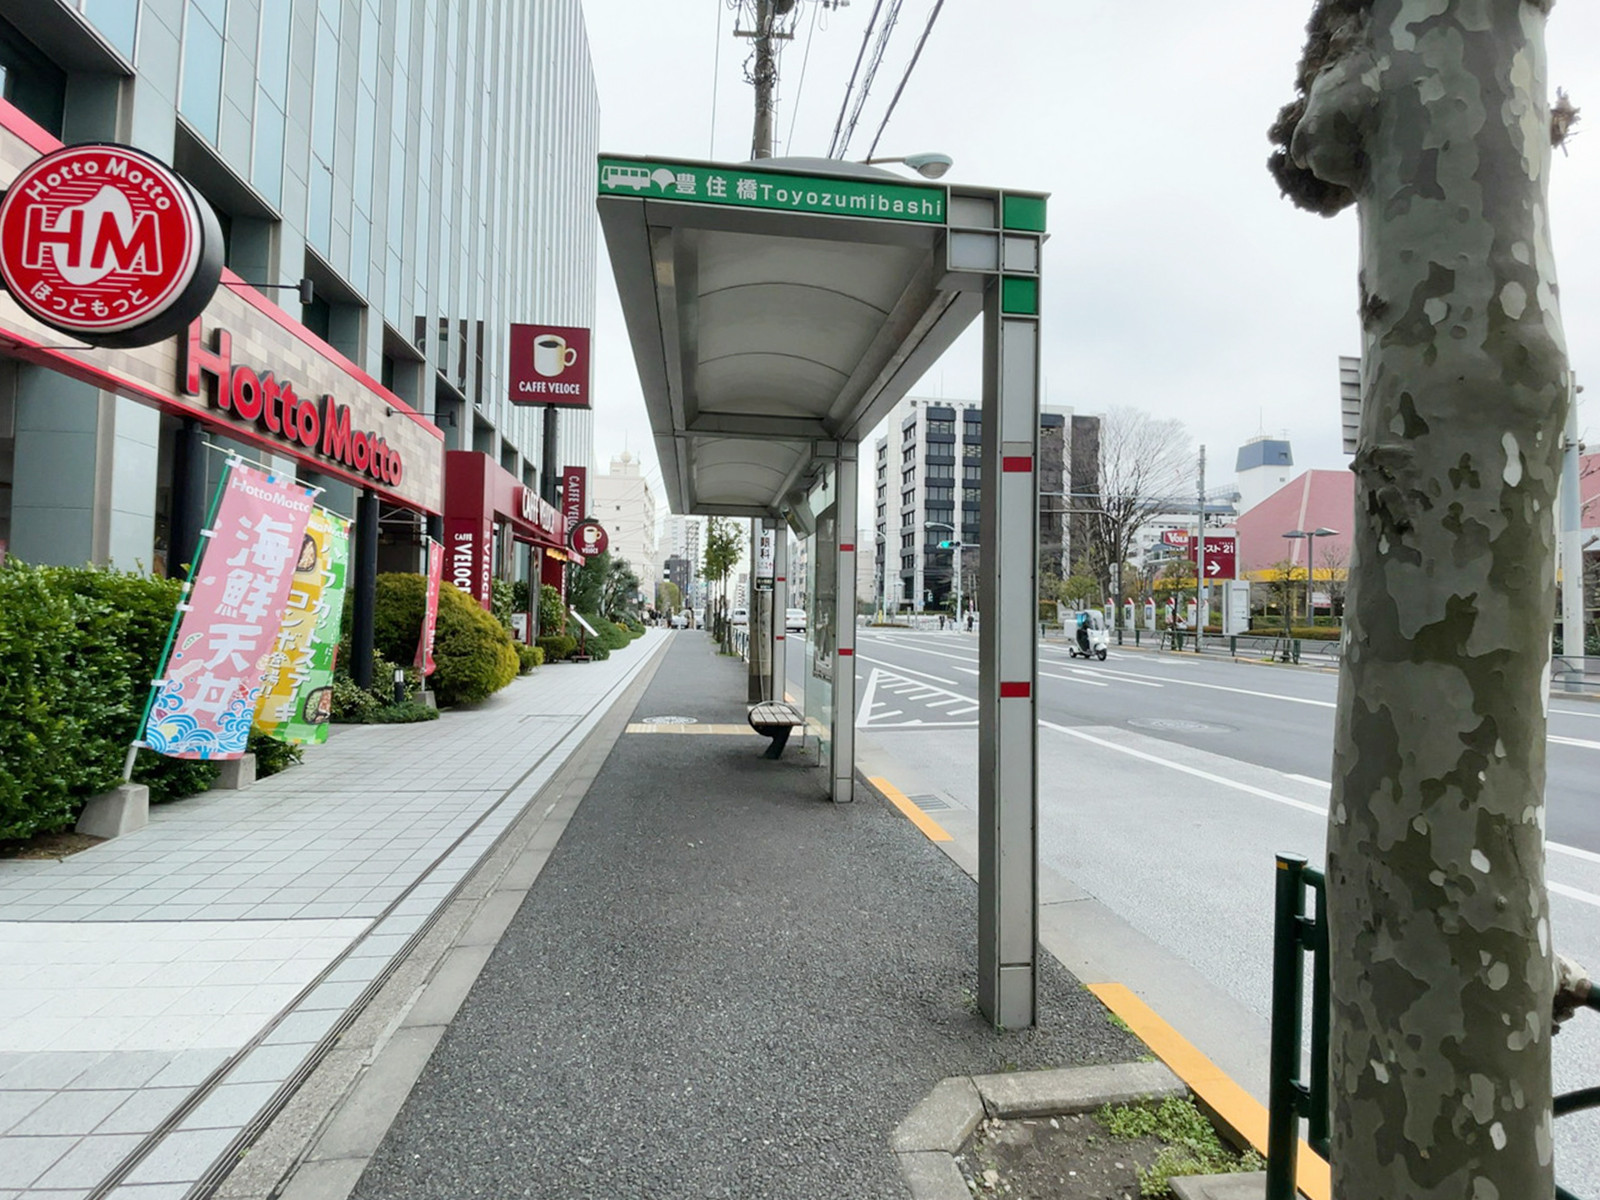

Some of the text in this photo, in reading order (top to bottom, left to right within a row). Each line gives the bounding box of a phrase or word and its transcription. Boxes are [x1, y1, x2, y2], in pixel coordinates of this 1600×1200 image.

[25, 156, 171, 211] Hotto Motto
[675, 171, 943, 217] 豊住橋 Toyozumibashi
[22, 204, 163, 276] HM
[29, 279, 149, 318] ほっともっと
[518, 380, 581, 395] CAFFE VELOCE
[454, 533, 473, 541] CAFFE
[1222, 544, 1234, 554] 21
[184, 513, 295, 722] 海鮮天丼
